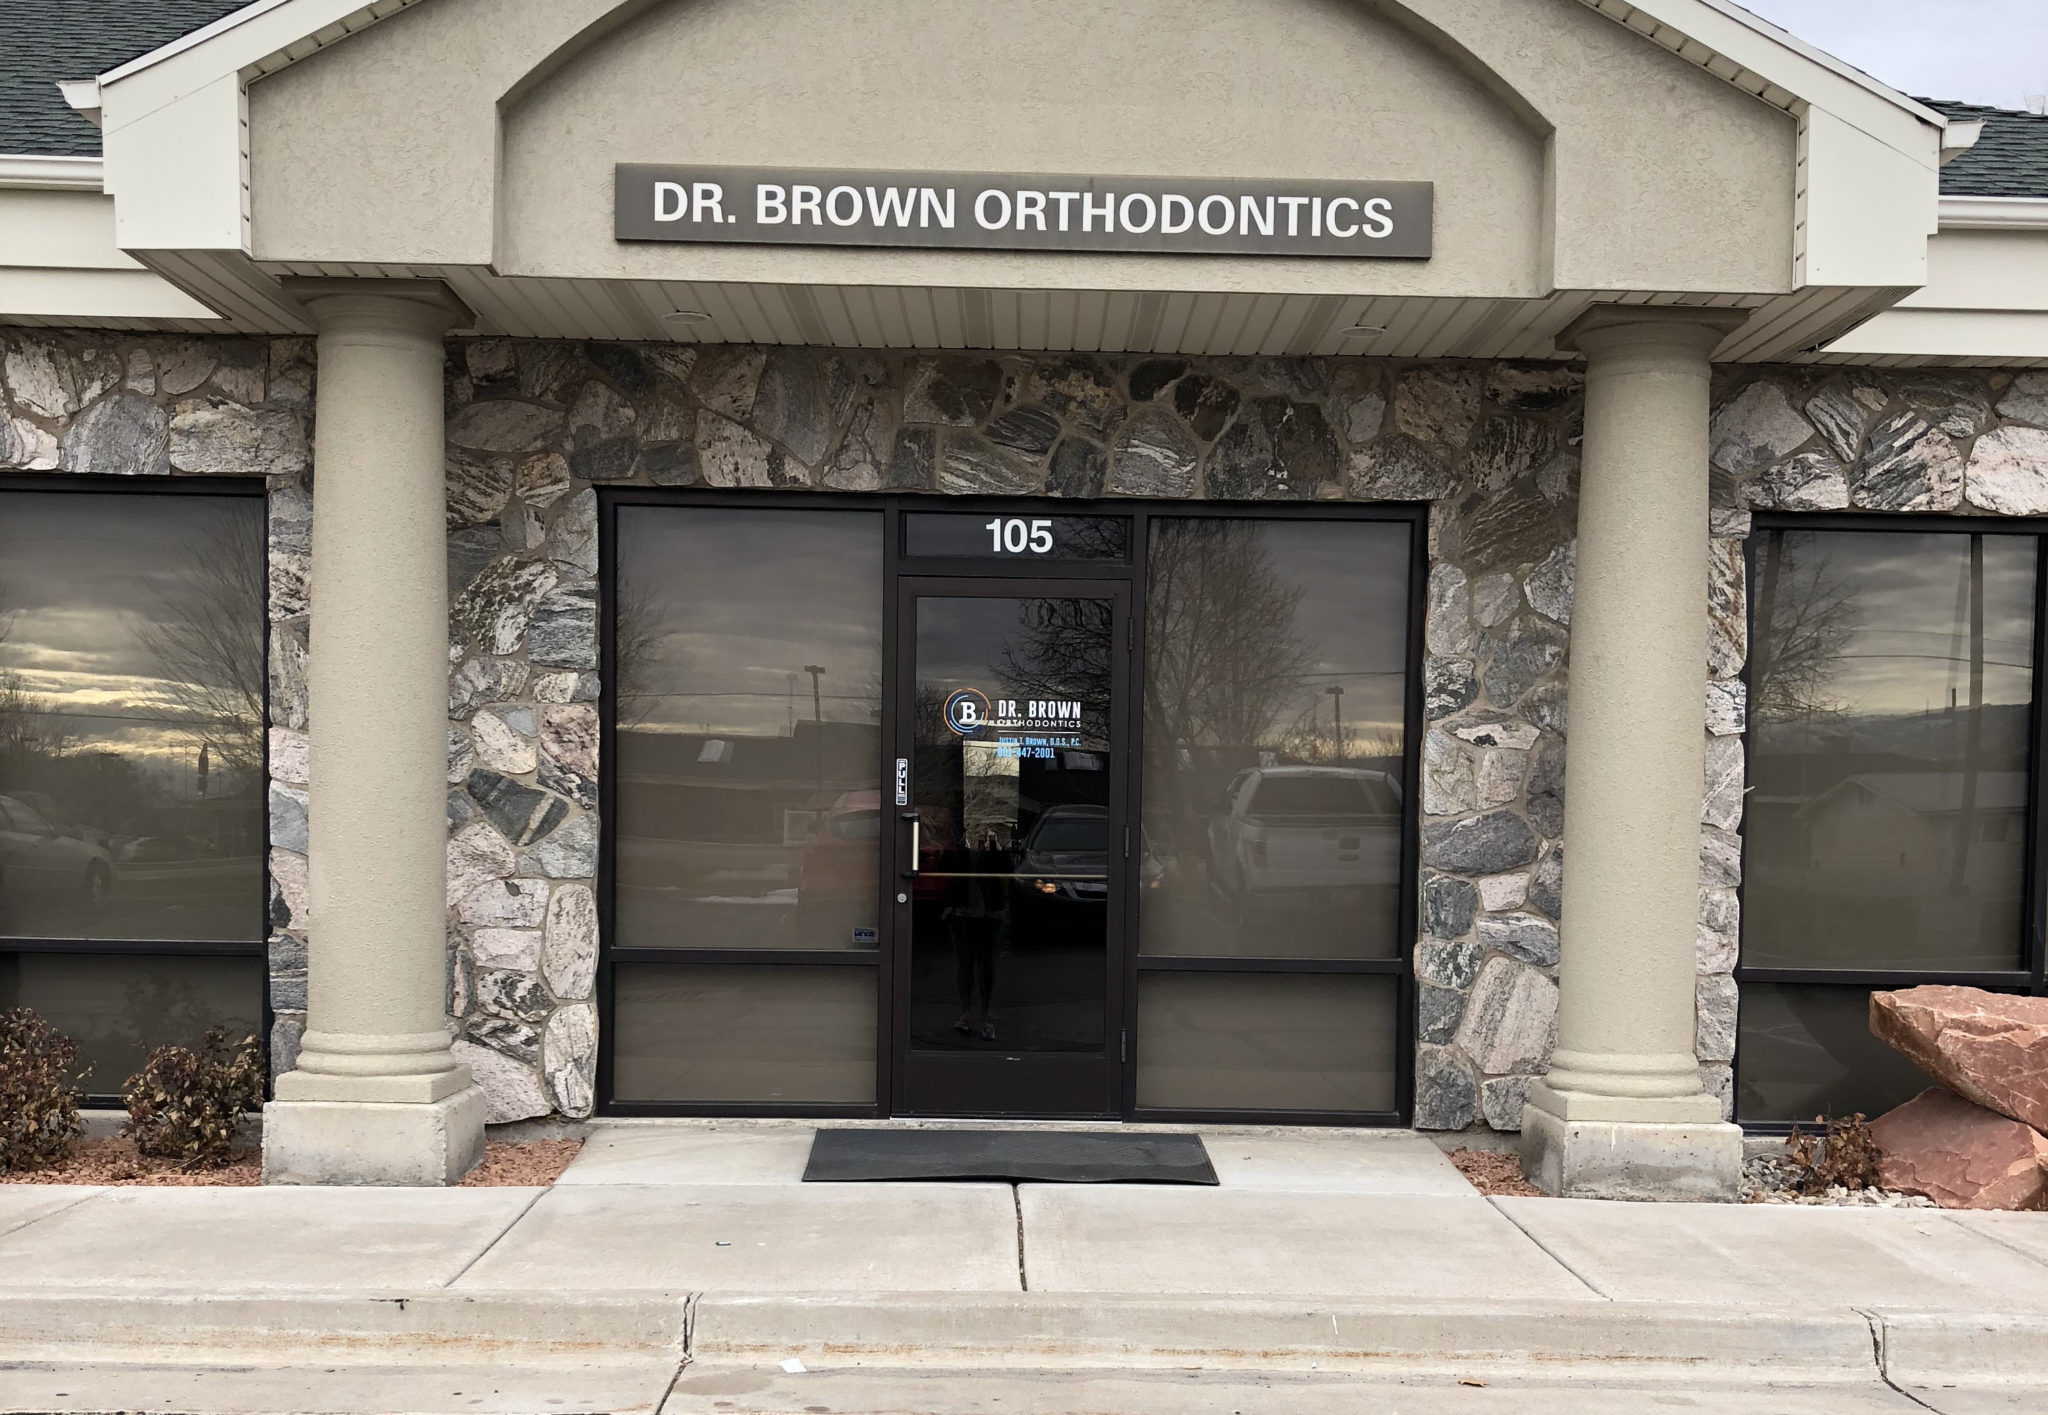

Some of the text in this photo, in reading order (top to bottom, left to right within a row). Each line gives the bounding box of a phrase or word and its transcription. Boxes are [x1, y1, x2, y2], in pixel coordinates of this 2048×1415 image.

[653, 181, 1395, 239] DR. BROWN ORTHODONTICS
[986, 518, 1053, 553] 105
[960, 701, 977, 723] B
[998, 700, 1081, 718] DR. BROWN
[997, 719, 1081, 728] ORTHODONTICS
[997, 747, 1055, 758] 801-447-2001
[898, 762, 906, 794] PULL
